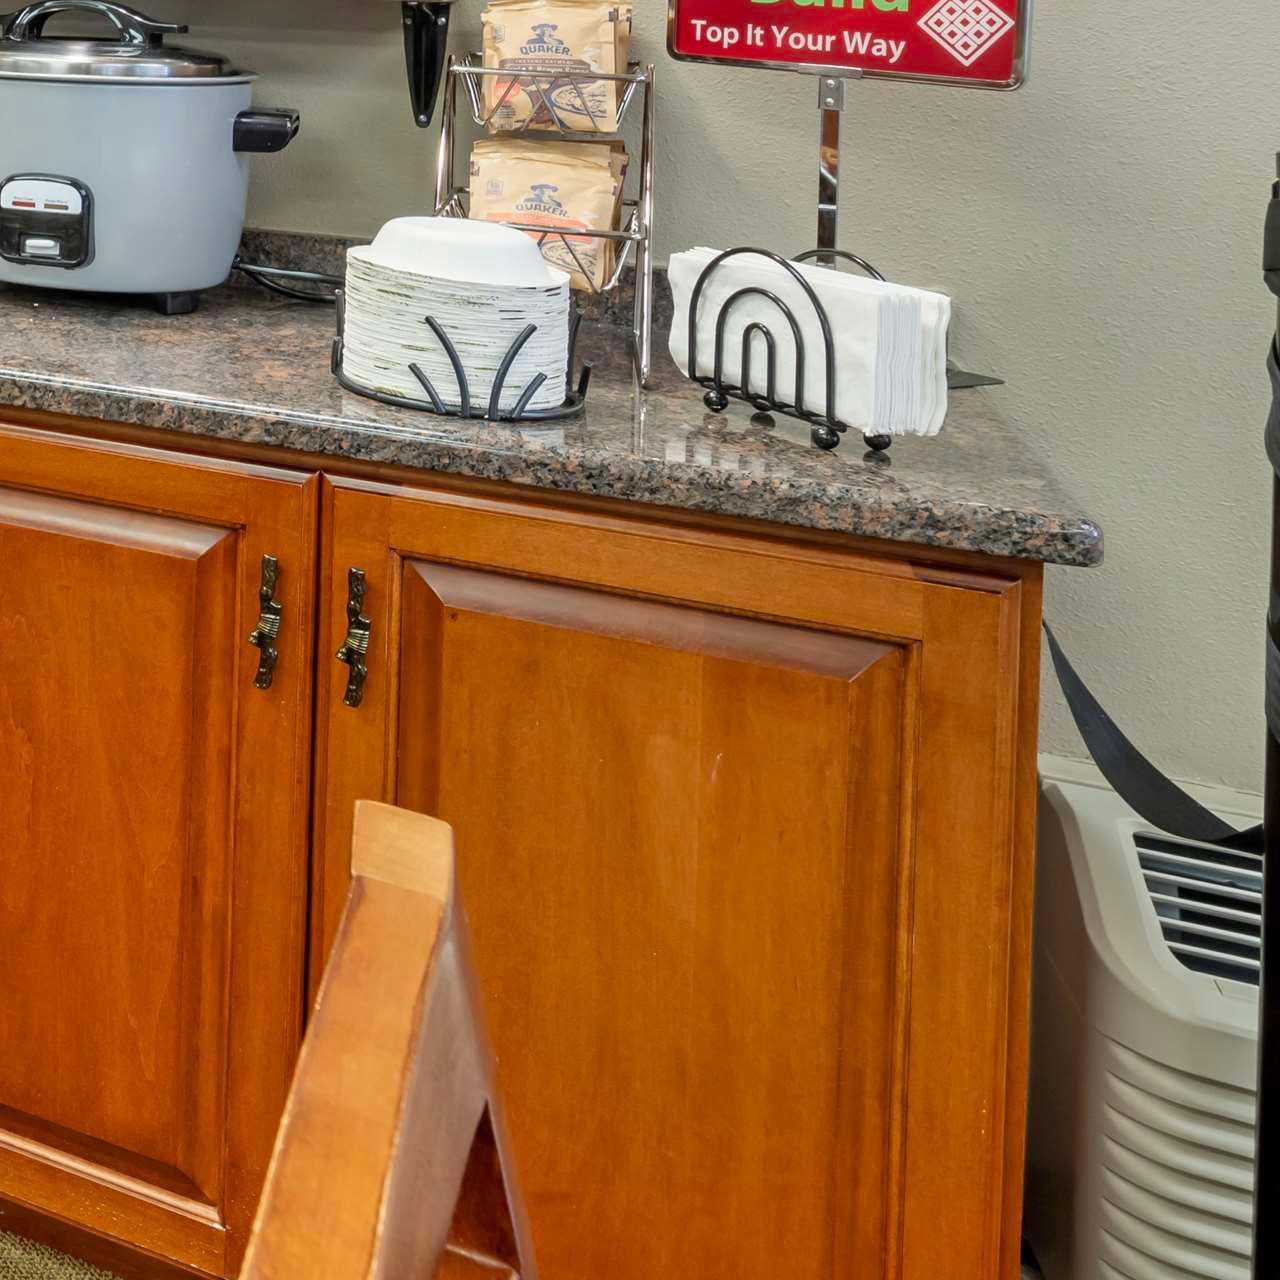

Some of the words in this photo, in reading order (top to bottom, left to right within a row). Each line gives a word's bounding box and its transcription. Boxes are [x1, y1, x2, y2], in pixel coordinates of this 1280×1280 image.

[691, 19, 739, 49] Top
[747, 24, 764, 47] It
[771, 26, 836, 52] Your
[842, 31, 907, 64] Way
[520, 44, 571, 56] QUAKER
[515, 203, 568, 217] QUAKER
